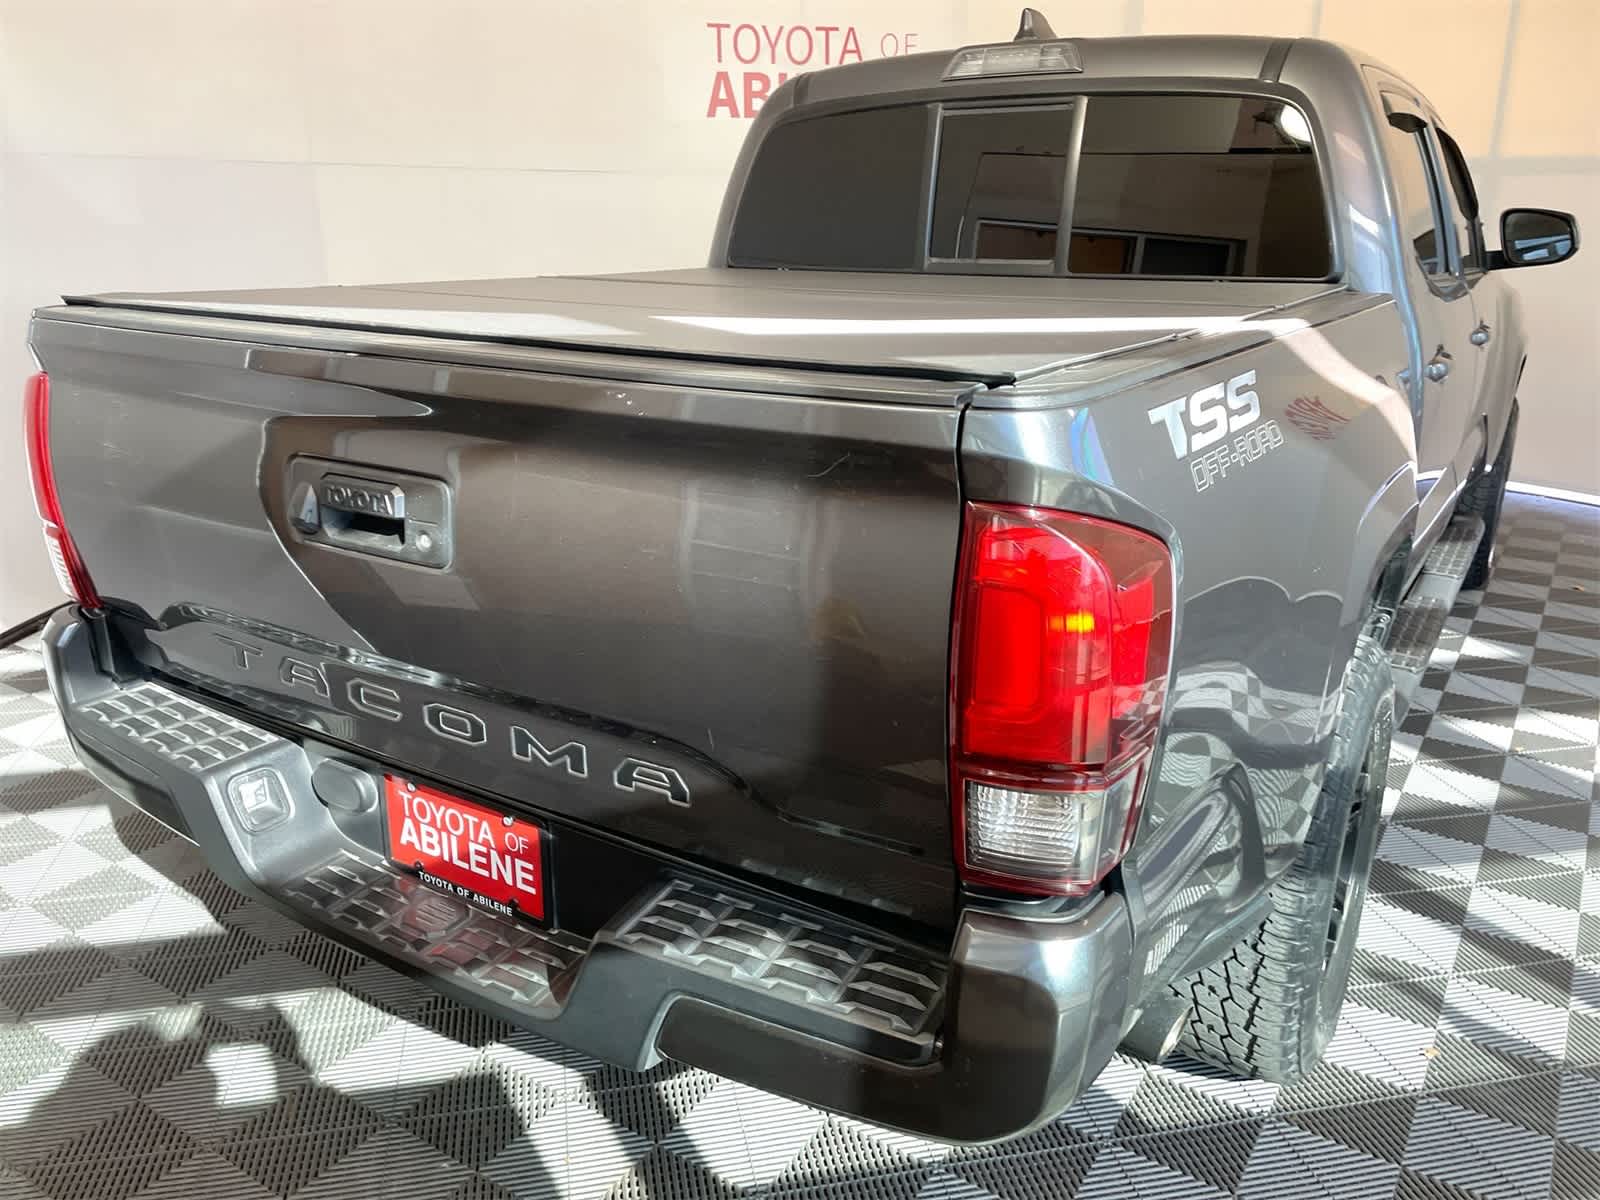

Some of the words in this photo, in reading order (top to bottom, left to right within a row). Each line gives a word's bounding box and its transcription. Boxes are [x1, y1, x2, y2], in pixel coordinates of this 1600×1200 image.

[706, 23, 863, 65] TOYOTA
[880, 33, 919, 58] OF
[1147, 369, 1261, 460] TSS
[1190, 419, 1285, 492] OFF-ROAD
[327, 484, 394, 515] TOYOTA
[214, 633, 692, 807] TACOMA
[398, 790, 495, 849] TOYOTA
[504, 831, 529, 855] OF
[400, 818, 537, 895] ABILENE
[418, 870, 454, 893] TOYOTA
[456, 886, 470, 898] OF
[473, 893, 513, 917] ABILENE
